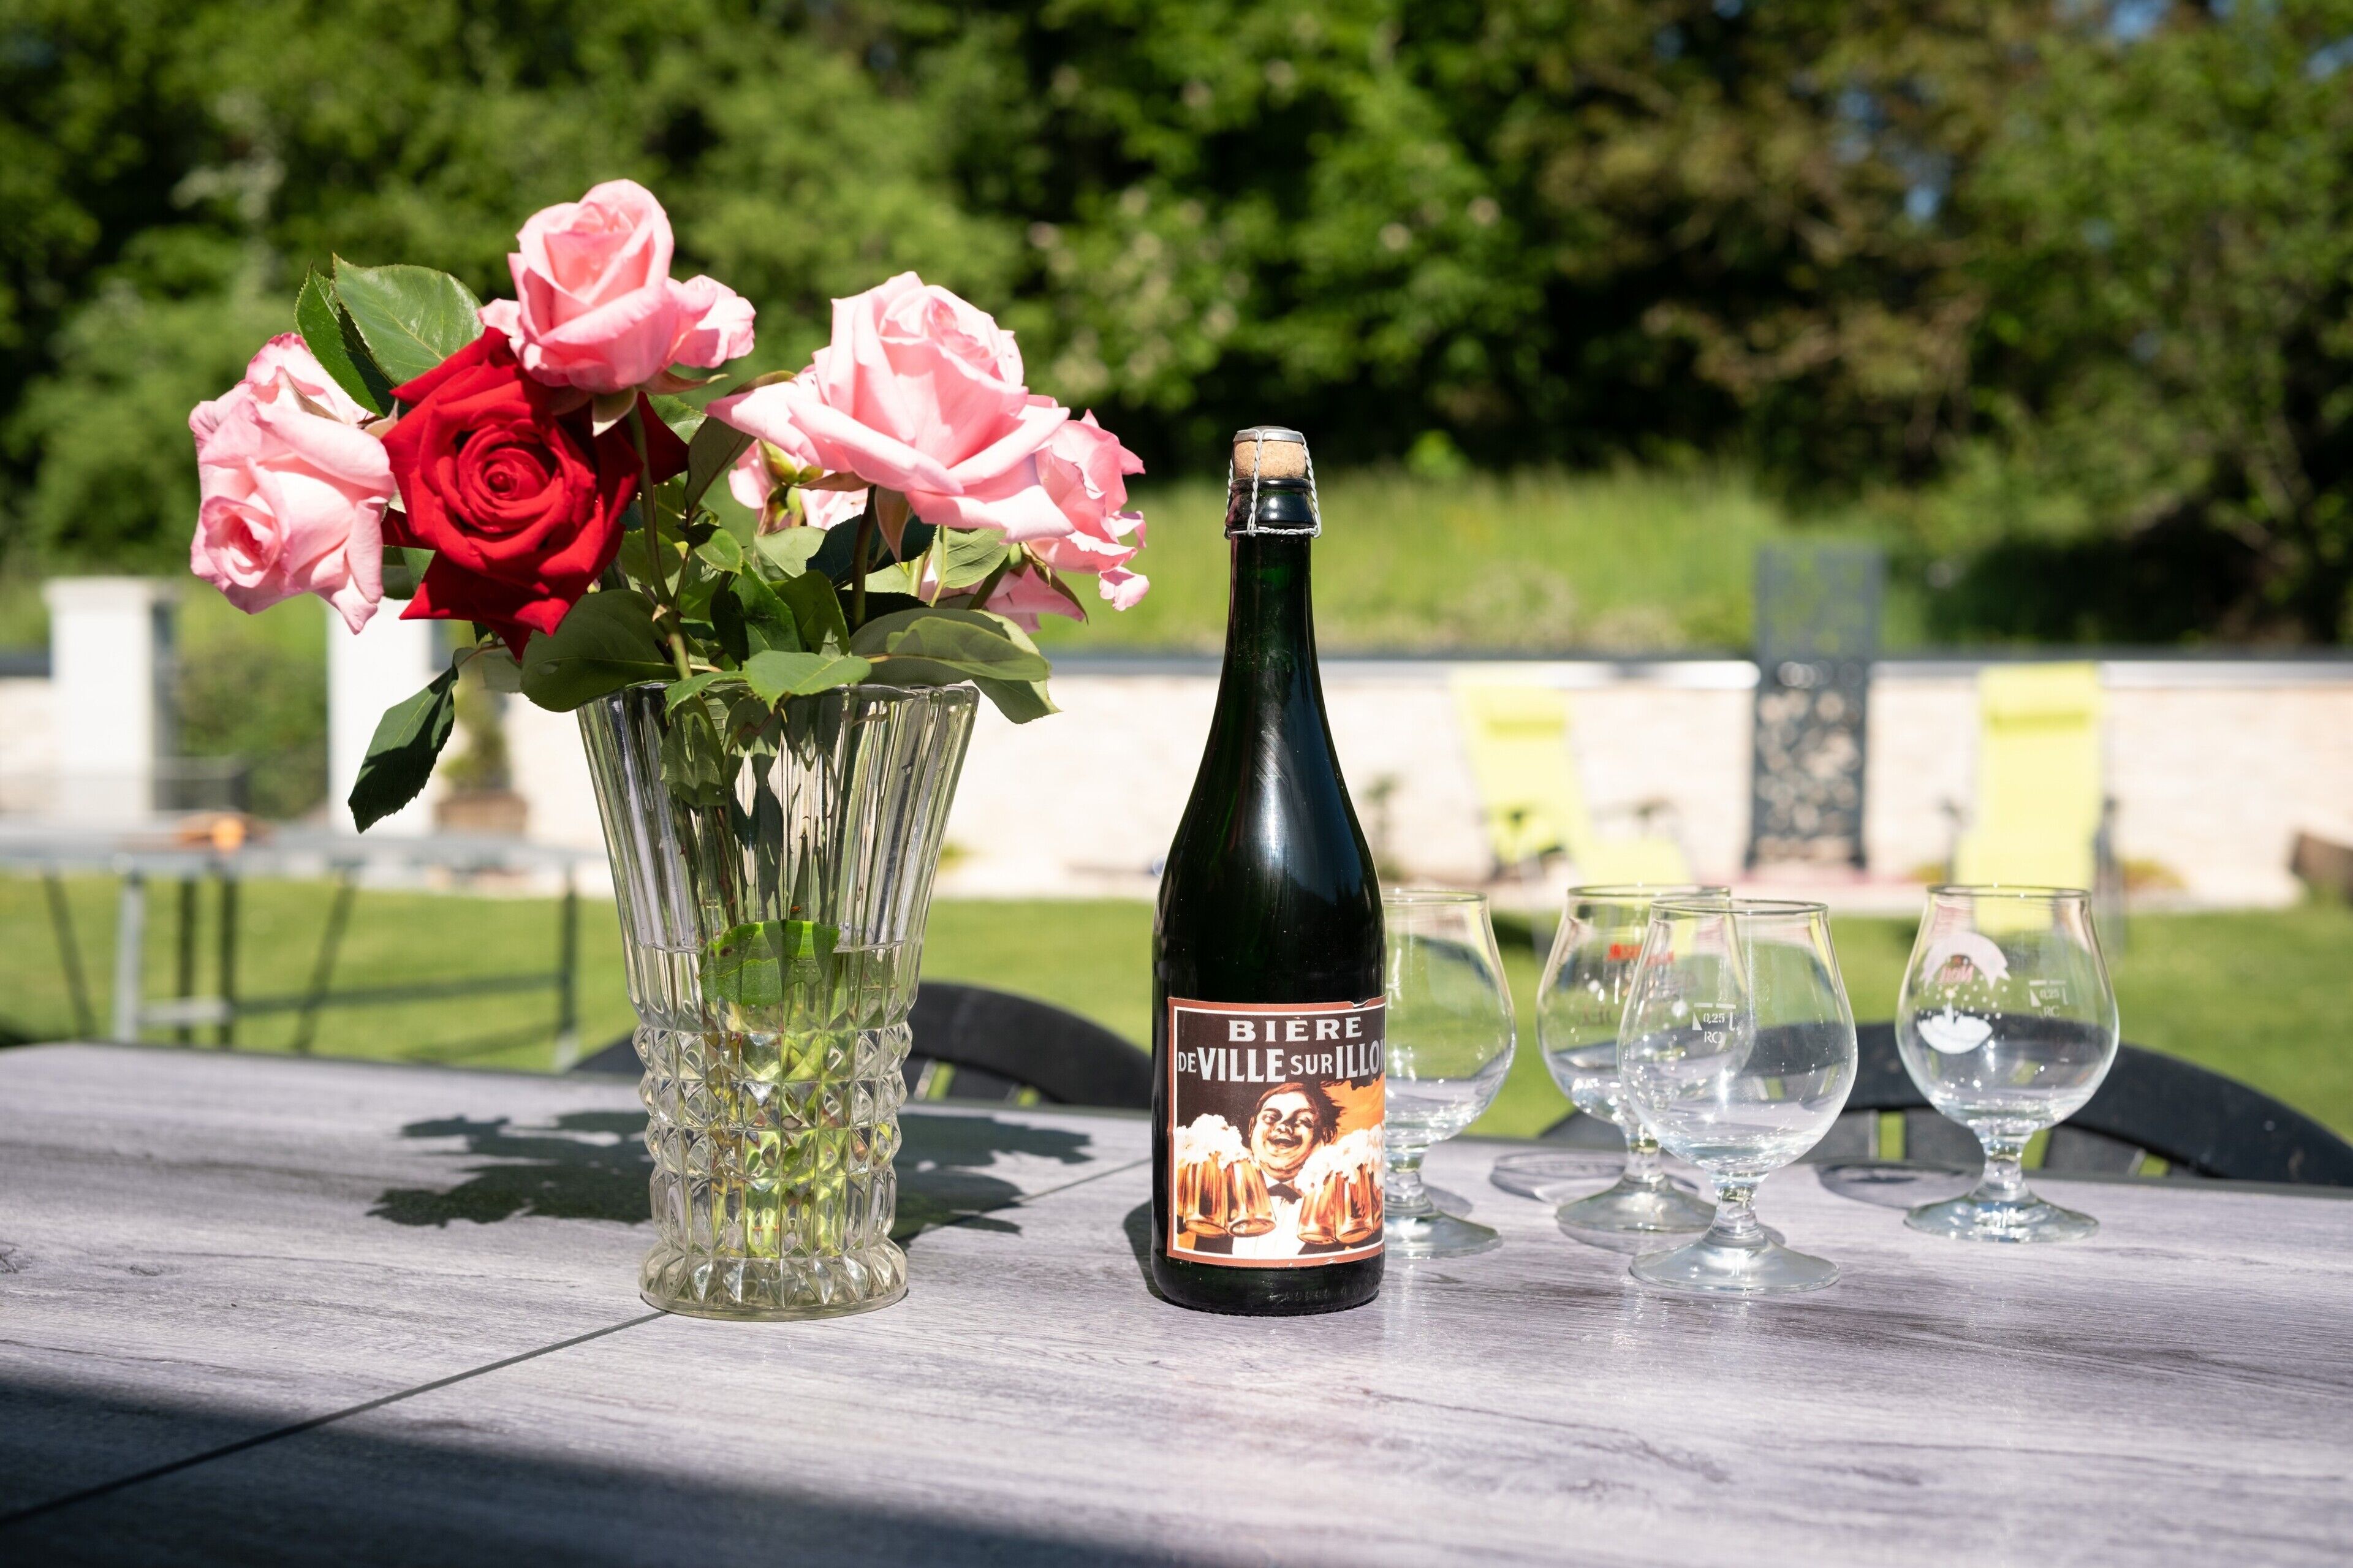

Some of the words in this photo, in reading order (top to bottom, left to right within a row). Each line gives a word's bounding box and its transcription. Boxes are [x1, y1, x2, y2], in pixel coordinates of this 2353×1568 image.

[1229, 1017, 1362, 1042] BIÈRE
[1703, 1013, 1725, 1024] 0,25
[1178, 1051, 1197, 1073] DE
[1197, 1047, 1286, 1082] VILLE
[1290, 1053, 1333, 1075] SUR
